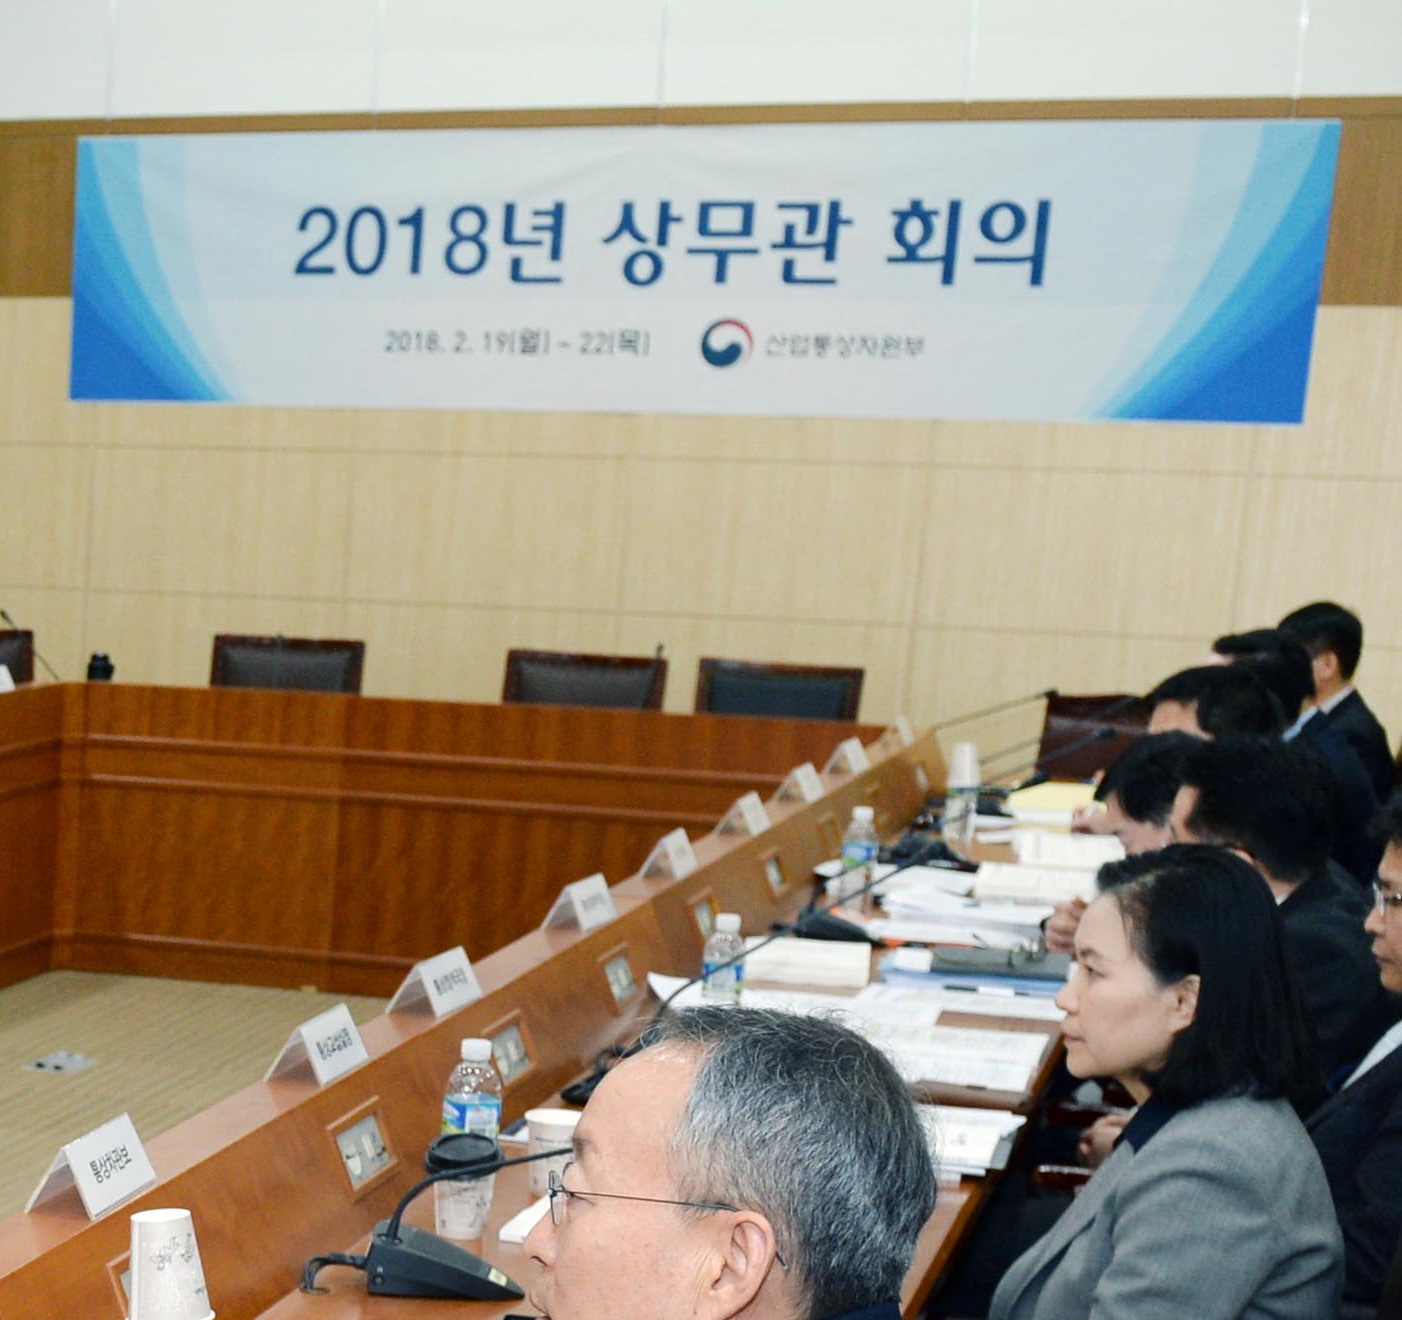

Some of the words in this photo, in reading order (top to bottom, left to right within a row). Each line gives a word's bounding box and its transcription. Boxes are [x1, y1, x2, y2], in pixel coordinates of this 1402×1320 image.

[293, 200, 567, 285] 2018년
[602, 198, 853, 287] 상무관
[886, 197, 1055, 288] 회의
[765, 332, 926, 360] 산업통상자원부
[90, 1144, 132, 1184] 통상차관보
